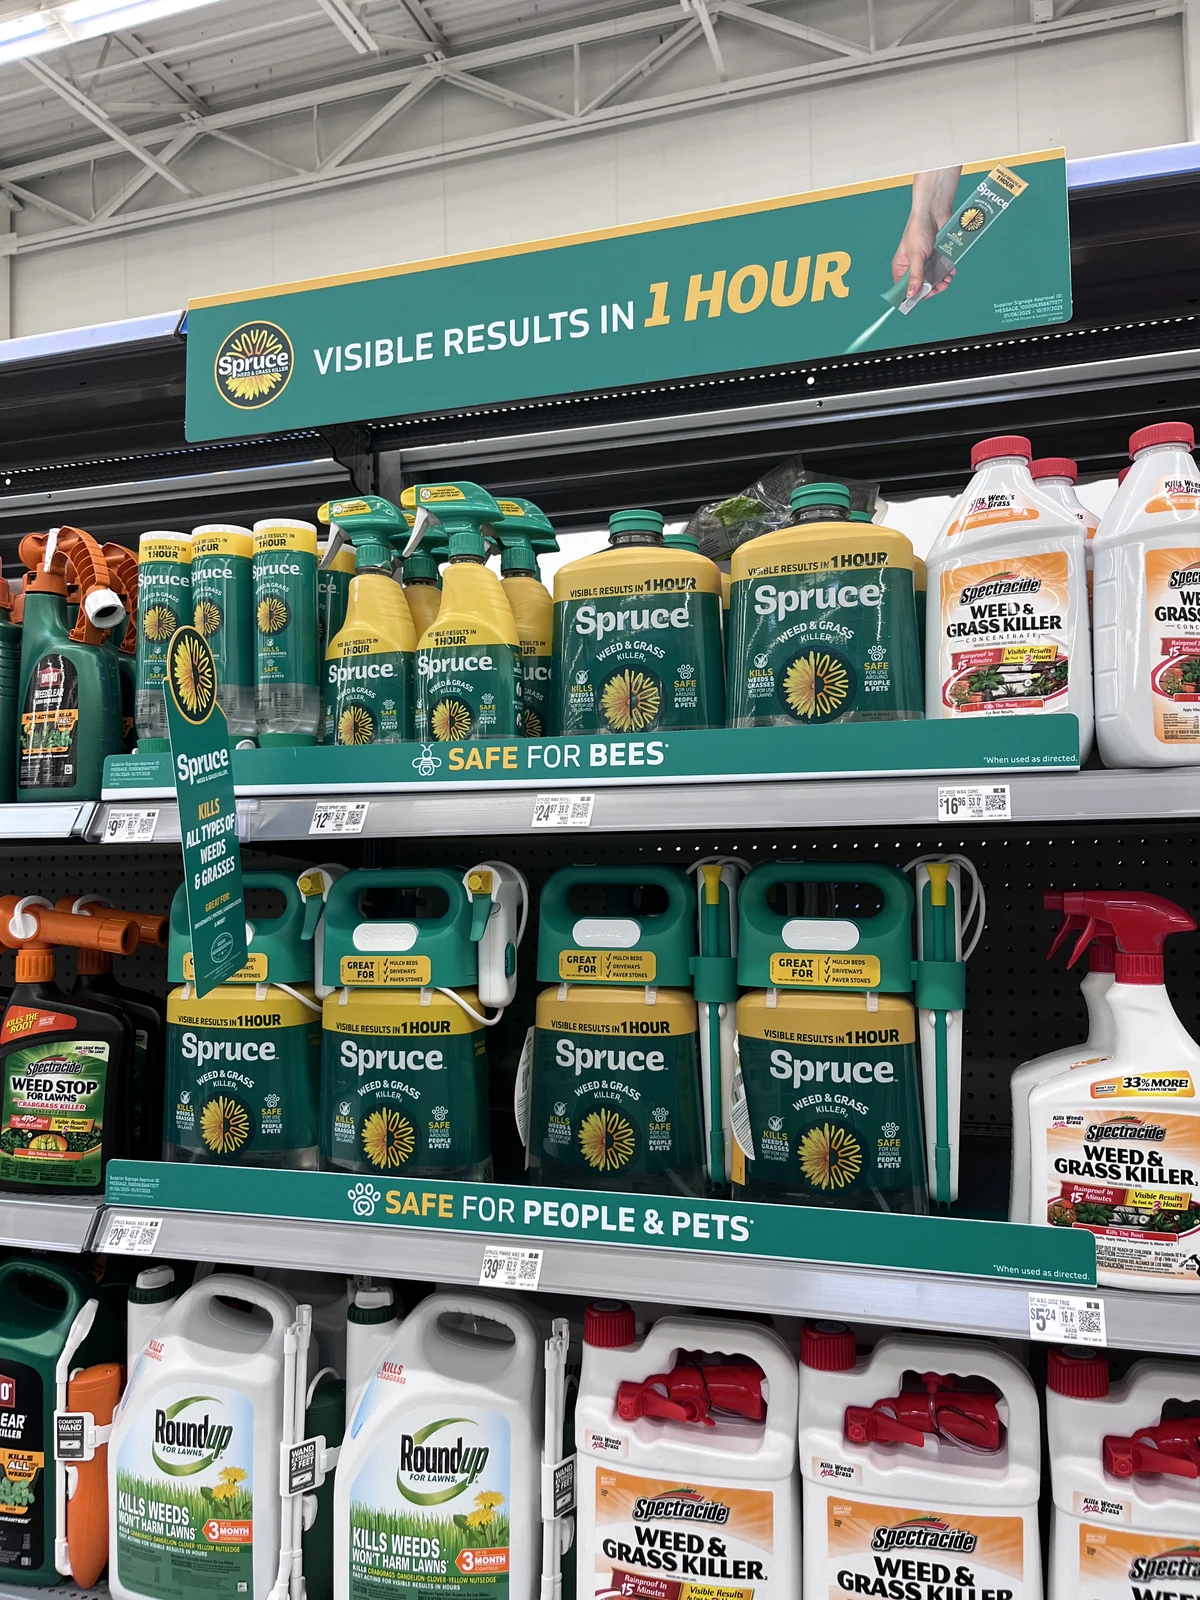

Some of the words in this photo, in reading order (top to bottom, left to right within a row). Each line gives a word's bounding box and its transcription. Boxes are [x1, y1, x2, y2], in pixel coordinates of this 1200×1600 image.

[977, 182, 1010, 210] Spruce
[993, 301, 1013, 309] Supplier
[1014, 298, 1033, 306] Signage
[1034, 295, 1055, 303] Approval
[313, 331, 433, 375] VISIBLE
[443, 308, 590, 357] RESULTS
[601, 300, 635, 334] IN
[643, 281, 670, 328] 1
[684, 251, 851, 322] HOUR
[218, 352, 289, 378] Spruce
[271, 365, 288, 373] KILLER
[960, 578, 1041, 605] Spectracide
[754, 584, 881, 622] Spruce
[970, 602, 1020, 620] WEED
[1022, 603, 1034, 615] &
[575, 606, 690, 641] Spruce
[946, 618, 1000, 638] GRASS
[1003, 615, 1062, 632] KILLER
[440, 636, 466, 646] HOUR
[417, 655, 493, 680] Spruce
[863, 662, 889, 670] SAFE
[328, 663, 393, 687] Spruce
[674, 680, 697, 688] SAFE
[448, 746, 518, 771] SAFE
[527, 744, 581, 769] FOR
[1010, 755, 1030, 763] used
[1042, 754, 1078, 763] directed.
[177, 748, 230, 785] Spruce
[198, 797, 220, 821] KILLS
[186, 827, 201, 849] ALL
[201, 817, 225, 842] TYPES
[225, 813, 235, 832] OF
[200, 838, 226, 865] WEEDS
[194, 873, 201, 890] &
[201, 856, 235, 887] GRASSES
[205, 897, 220, 912] GREAT
[347, 961, 375, 970] GREAT
[566, 955, 597, 964] GREAT
[778, 958, 814, 968] GREAT
[357, 970, 375, 979] FOR
[577, 965, 597, 974] FOR
[791, 968, 814, 978] FOR
[10, 1020, 34, 1034] ROOT
[764, 1029, 795, 1041] VISIBLE
[797, 1033, 834, 1044] RESULTS
[835, 1036, 845, 1044] IN
[845, 1031, 853, 1044] 1
[855, 1029, 900, 1044] HOUR
[181, 1032, 276, 1067] Spruce
[340, 1040, 443, 1076] Spruce
[555, 1039, 665, 1076] Spruce
[26, 1061, 82, 1077] Spectracide
[769, 1049, 895, 1089] Spruce
[12, 1077, 53, 1093] WEED
[56, 1079, 98, 1095] STOP
[1122, 1076, 1150, 1088] 33%
[1151, 1078, 1189, 1088] MORE!
[18, 1100, 58, 1110] CRABGRASS
[59, 1103, 85, 1111] KILLER
[26, 1091, 43, 1101] FOR
[44, 1093, 77, 1103] LAWNS
[261, 1108, 282, 1116] SAFE
[428, 1121, 450, 1129] SAFE
[648, 1123, 672, 1131] SAFE
[1086, 1124, 1167, 1143] Spectracide
[877, 1139, 901, 1147] SAFE
[1083, 1145, 1144, 1165] WEED
[1146, 1151, 1164, 1167] &
[1054, 1158, 1122, 1181] GRASS
[1070, 1193, 1083, 1204] 15
[1085, 1193, 1112, 1202] Minutes
[1073, 1185, 1106, 1195] Rainproof
[1134, 1191, 1158, 1200] Visible
[1158, 1193, 1183, 1202] Results
[385, 1189, 454, 1219] SAFE
[462, 1195, 516, 1224] FOR
[523, 1199, 636, 1233] PEOPLE
[643, 1208, 665, 1235] &
[1021, 1268, 1040, 1276] used
[1053, 1269, 1090, 1280] directed.
[382, 1361, 404, 1376] KILLS
[376, 1371, 407, 1384] CRABGRASS
[155, 1408, 233, 1460] Roundup
[7, 1453, 34, 1462] KILLS
[291, 1444, 315, 1458] WAND
[400, 1434, 490, 1484] Roundup
[8, 1460, 30, 1471] ALL
[291, 1462, 297, 1471] 2
[298, 1456, 315, 1469] FEET
[119, 1491, 146, 1517] KILLS
[148, 1500, 190, 1526] WEEDS
[633, 1497, 730, 1525] Spectracide
[1083, 1497, 1099, 1506] Kills
[1100, 1500, 1123, 1511] Weeds
[1100, 1507, 1120, 1515] Grass
[208, 1521, 220, 1540] 3
[220, 1527, 250, 1535] MONTH
[353, 1527, 388, 1553] KILLS
[391, 1534, 440, 1559] WEEDS
[634, 1525, 705, 1555] WEED
[707, 1536, 727, 1558] &
[871, 1526, 978, 1553] Spectracide
[352, 1547, 380, 1564] WON'T
[382, 1554, 410, 1571] HARM
[462, 1551, 474, 1571] 3
[474, 1556, 506, 1564] MONTH
[602, 1538, 678, 1572] GRASS
[352, 1564, 367, 1573] KILLS
[367, 1567, 395, 1578] CRABGRASS
[396, 1573, 425, 1582] DANDELION
[427, 1575, 447, 1583] CLOVER
[873, 1556, 951, 1583] WEED
[954, 1566, 975, 1587] &
[690, 1586, 716, 1597] Visible
[717, 1588, 744, 1599] Results
